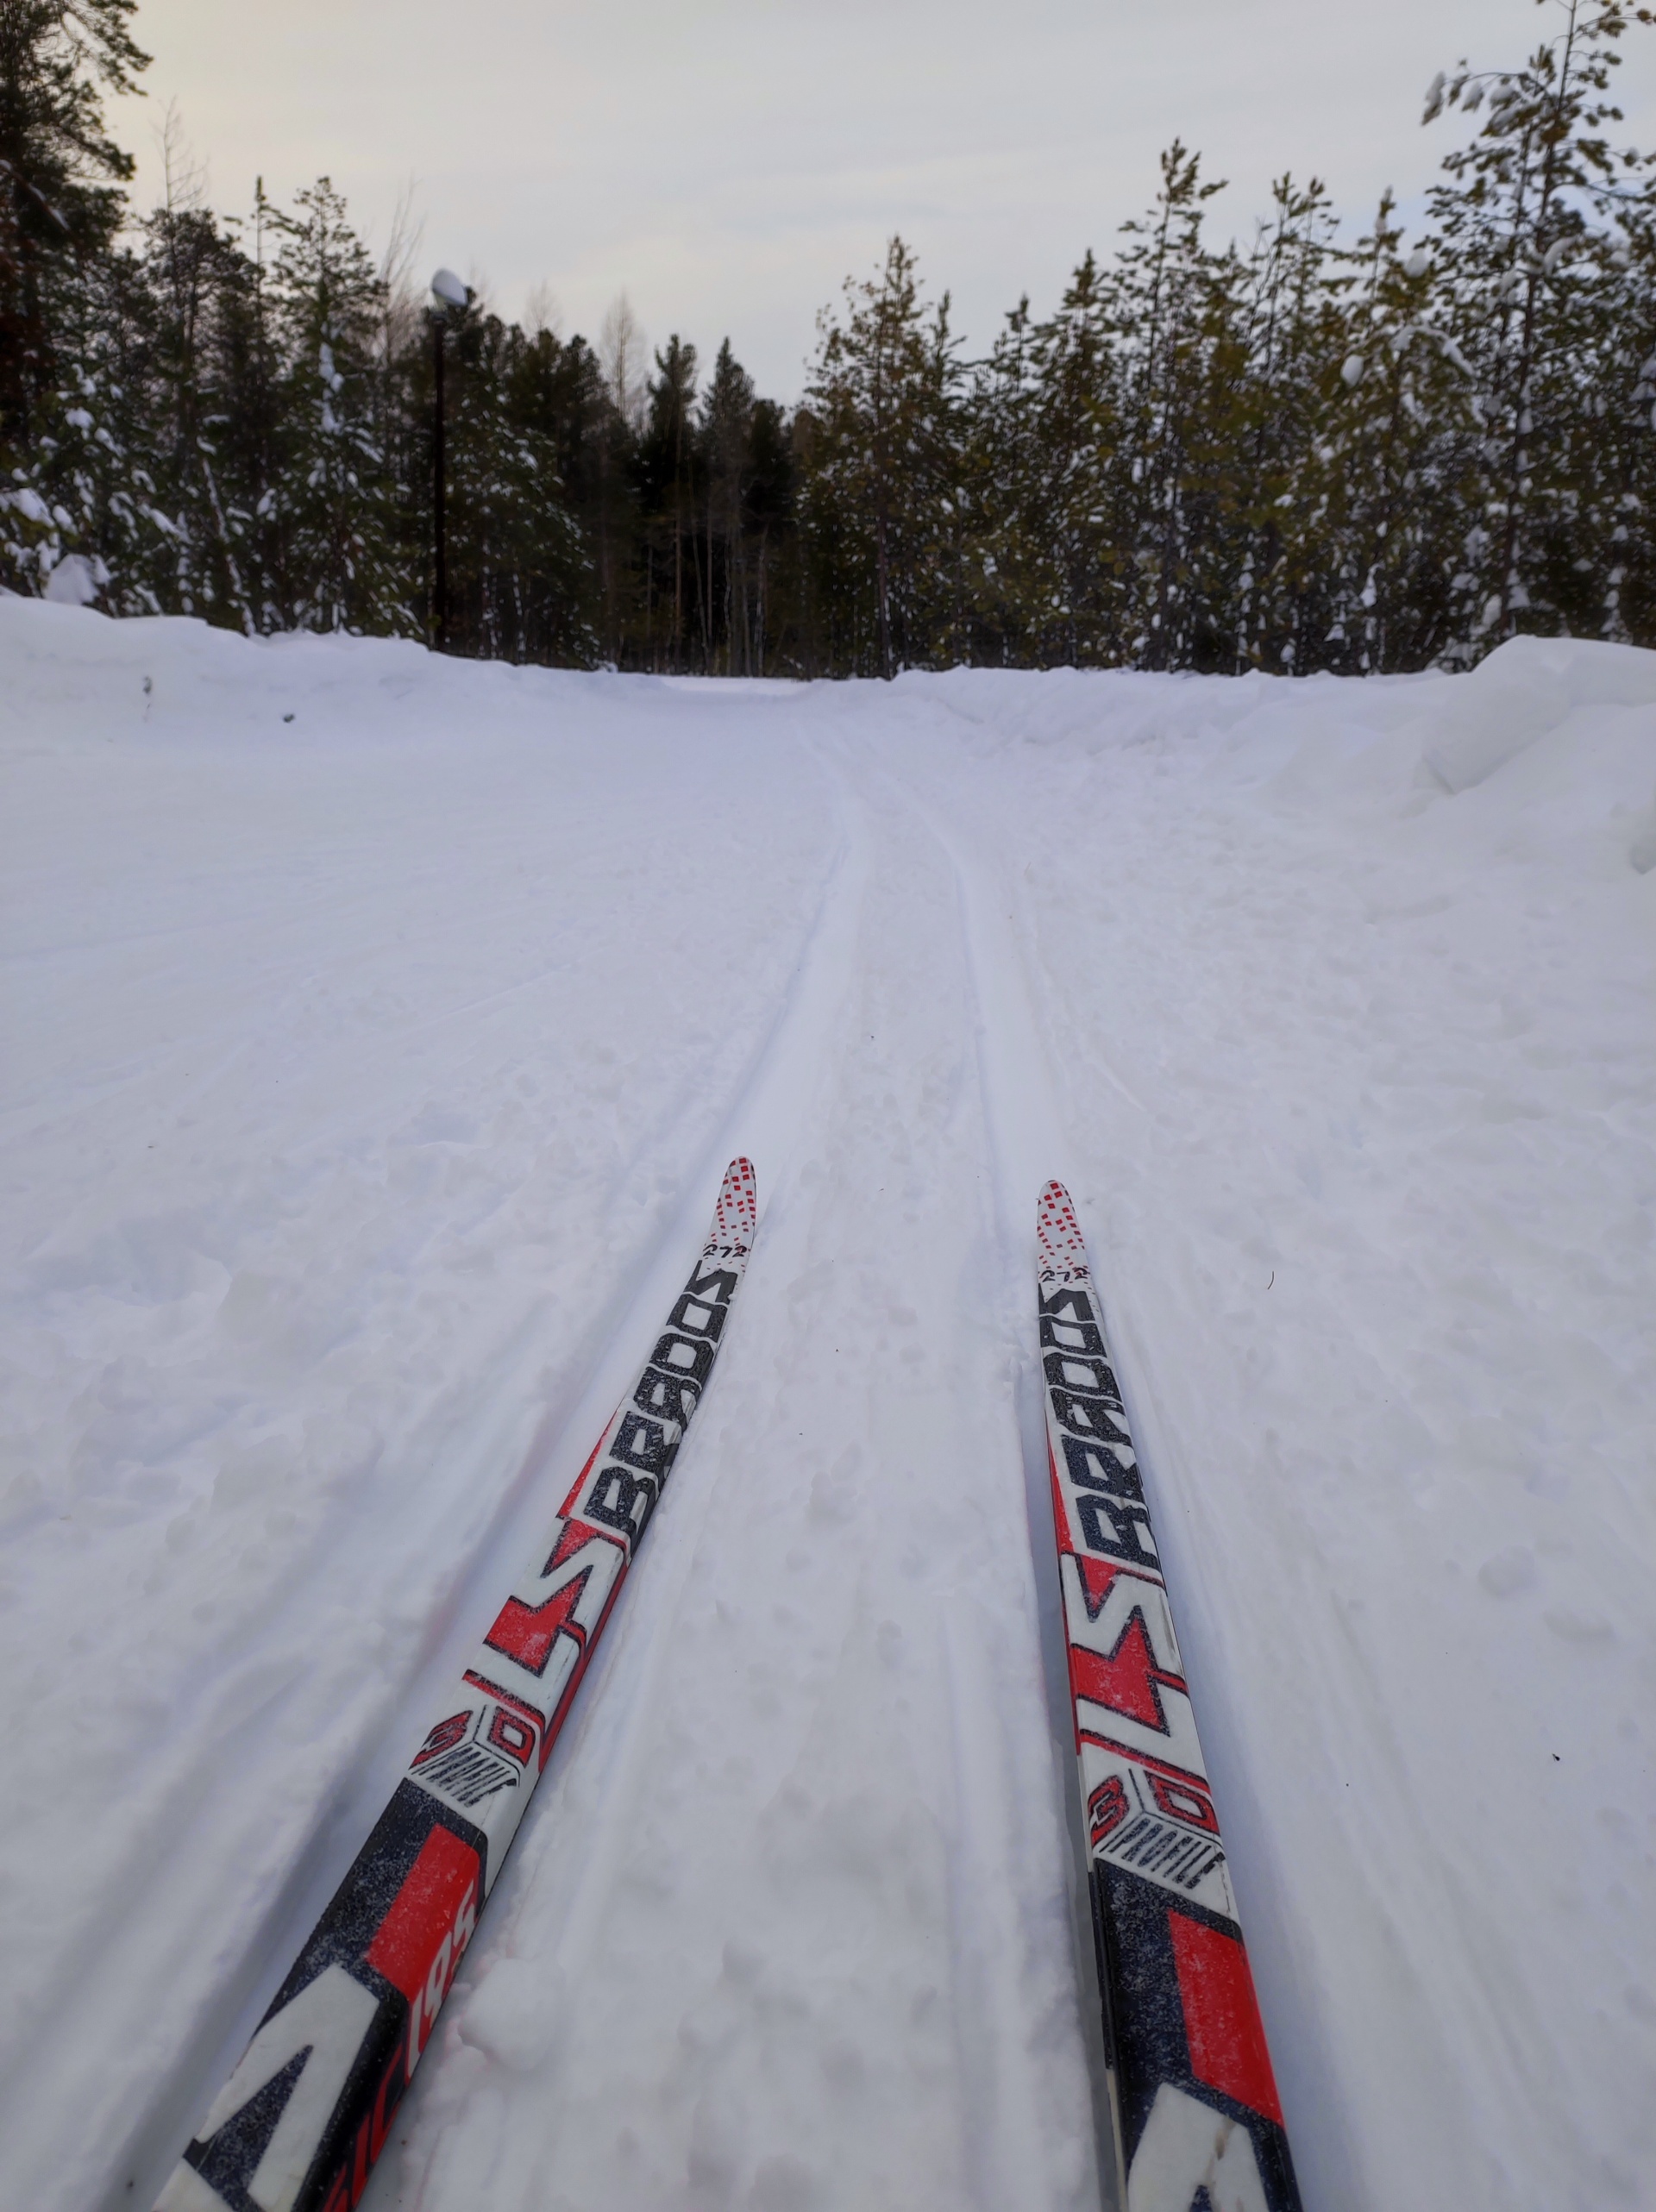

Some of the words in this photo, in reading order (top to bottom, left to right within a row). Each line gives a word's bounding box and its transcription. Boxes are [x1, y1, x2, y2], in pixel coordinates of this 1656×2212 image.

[702, 1244, 748, 1258] 272
[1039, 1267, 1088, 1282] 272
[583, 1260, 738, 1557] BRADOS
[1038, 1282, 1162, 1573] BRADOS
[1088, 1770, 1221, 1849] 3D
